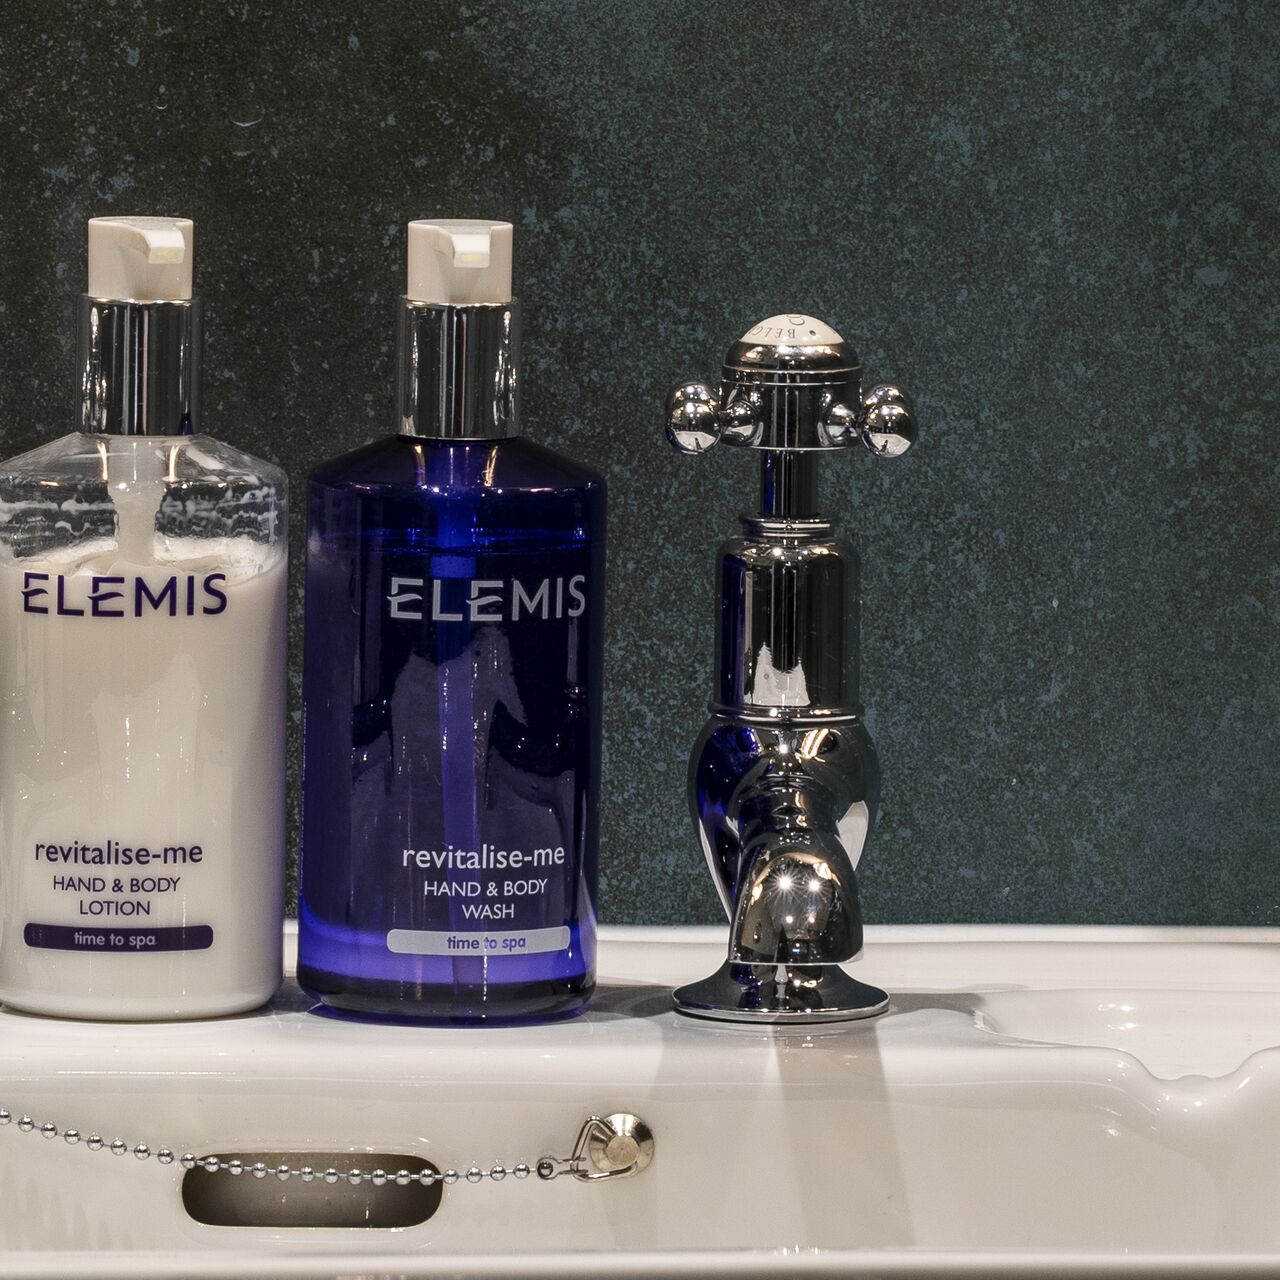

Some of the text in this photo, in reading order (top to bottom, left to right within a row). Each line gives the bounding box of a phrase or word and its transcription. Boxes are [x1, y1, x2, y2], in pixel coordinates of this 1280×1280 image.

[21, 572, 228, 617] ELEMIS
[387, 575, 586, 621] ELEMIS
[35, 840, 203, 865] revitalise-me
[402, 844, 565, 869] revitalise-me
[53, 876, 181, 892] HAND & BODY
[424, 879, 548, 896] HAND & BODY
[80, 900, 150, 915] LOTION
[462, 904, 514, 919] WASH
[74, 931, 156, 949] time to spa
[447, 936, 526, 951] time to spa
